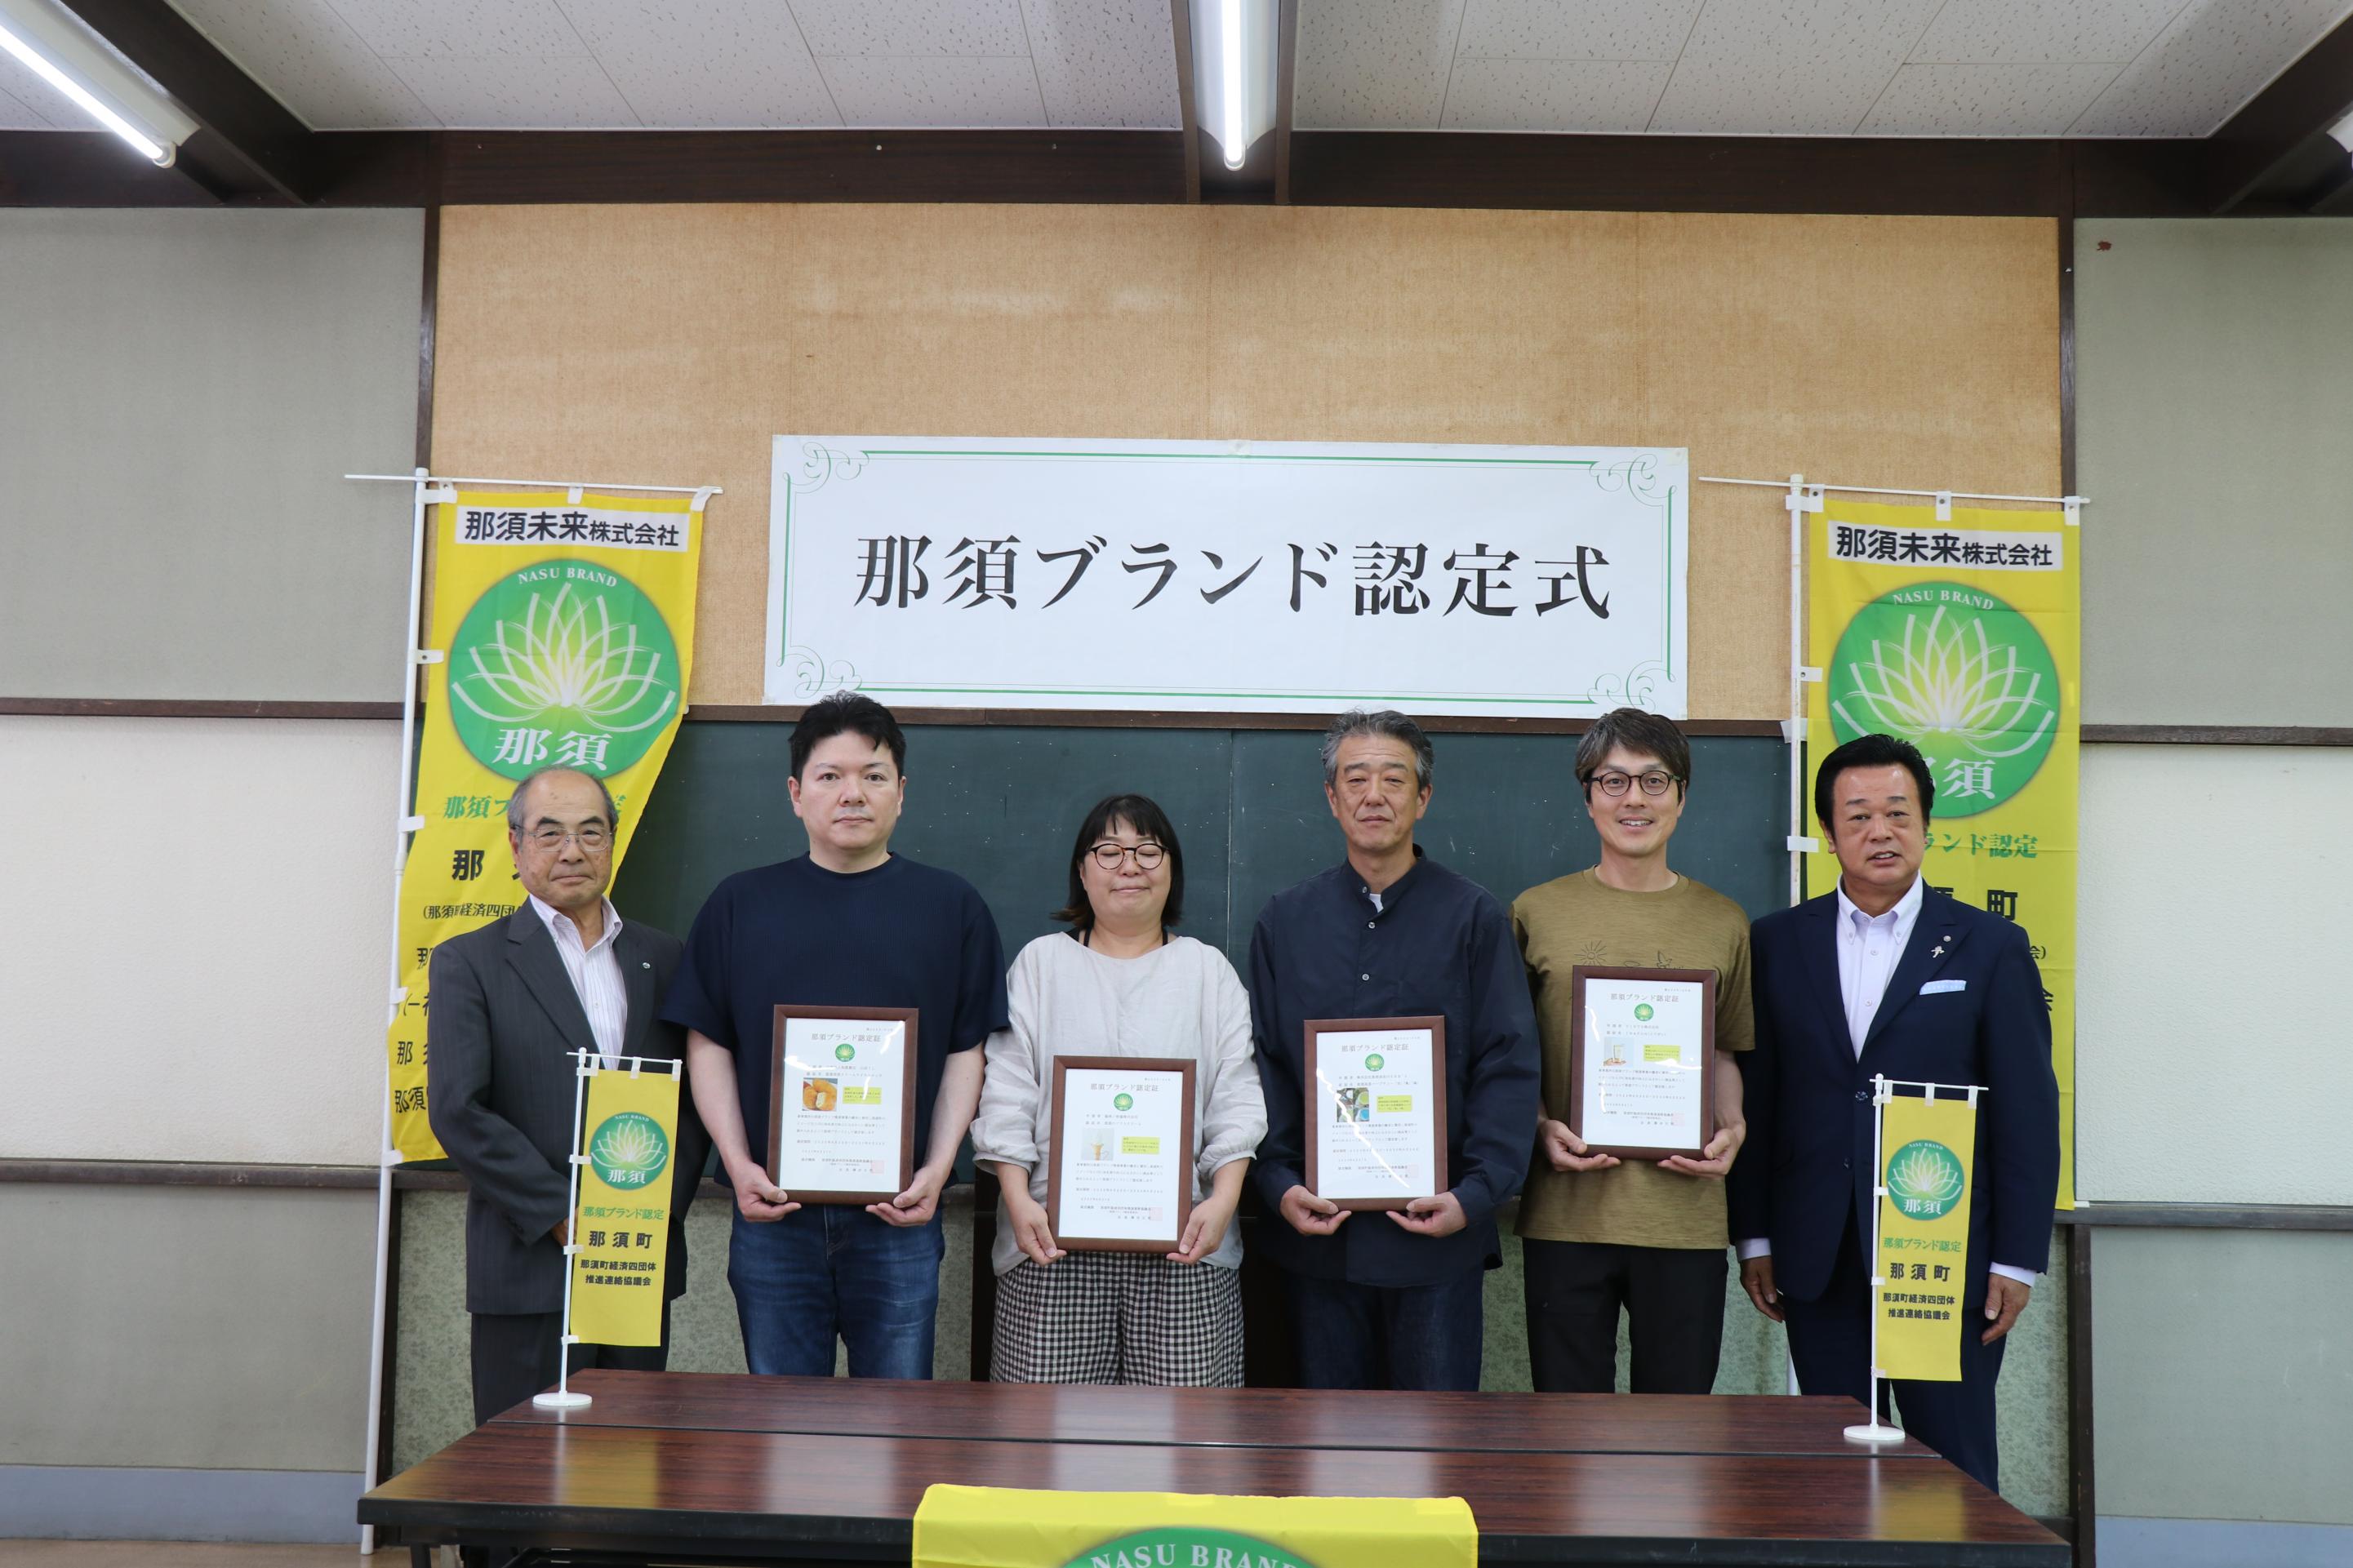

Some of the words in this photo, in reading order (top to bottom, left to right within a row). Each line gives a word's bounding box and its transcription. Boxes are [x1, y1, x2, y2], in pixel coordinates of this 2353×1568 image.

[465, 510, 679, 547] 那須未来株式会社
[1835, 526, 2053, 566] 那須未来株式会社
[518, 567, 560, 584] NASU
[567, 567, 617, 587] BRAND
[854, 533, 1611, 620] 那須ブランド認定式
[1893, 589, 1933, 605] NASU
[1940, 590, 1994, 611] BRAND
[492, 727, 613, 771] 那須
[607, 1169, 646, 1184] 那須
[583, 1206, 665, 1220] 那須ブランド認定
[1903, 1199, 1942, 1215] 那須
[589, 1231, 652, 1249] 那須町
[1883, 1237, 1962, 1253] 那須ブランド認定
[580, 1259, 656, 1272] 那須町経済四団体
[1890, 1263, 1950, 1281] 那須町
[585, 1274, 652, 1286] 推進連絡協議会
[1883, 1292, 1955, 1305] 那須町経済四団体
[1888, 1308, 1950, 1320] 推進連絡協議会
[1091, 1544, 1176, 1568] NASU
[1190, 1544, 1297, 1568] BRAN
